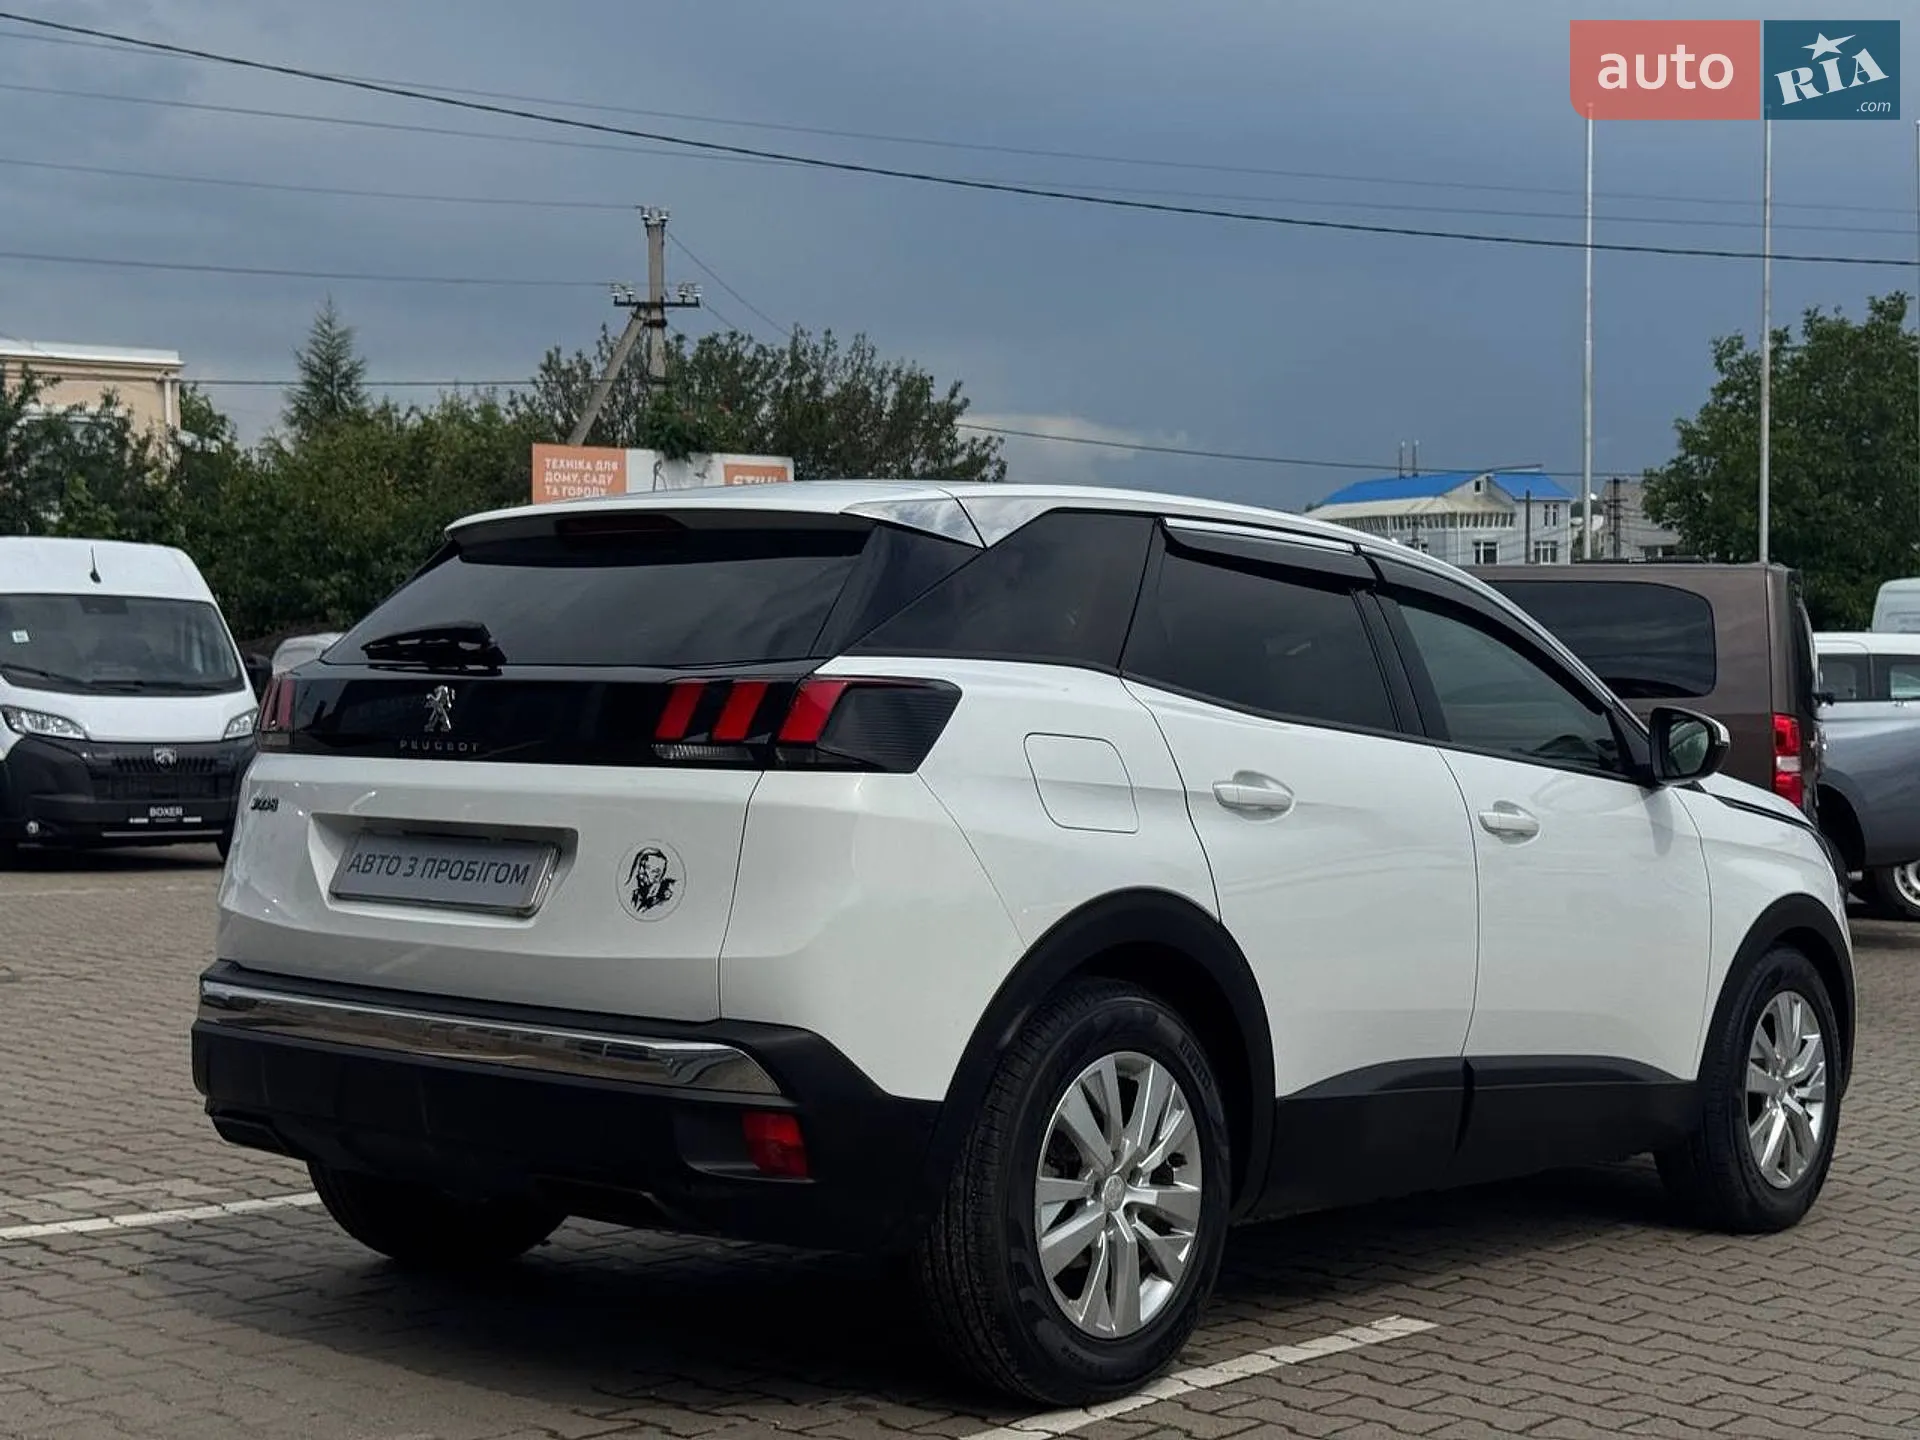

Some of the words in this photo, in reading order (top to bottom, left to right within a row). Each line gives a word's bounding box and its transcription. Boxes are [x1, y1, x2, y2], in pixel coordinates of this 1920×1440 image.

[544, 458, 592, 471] ТЕХНІКА
[595, 460, 618, 472] ДЛЯ
[544, 471, 581, 484] ДОМУ,
[583, 472, 614, 486] САДУ
[544, 484, 559, 497] ТА
[400, 739, 480, 752] PEUGEOT
[149, 806, 183, 817] BOXER
[347, 852, 401, 876] АВТО
[419, 857, 531, 886] ПРОБІГОМ
